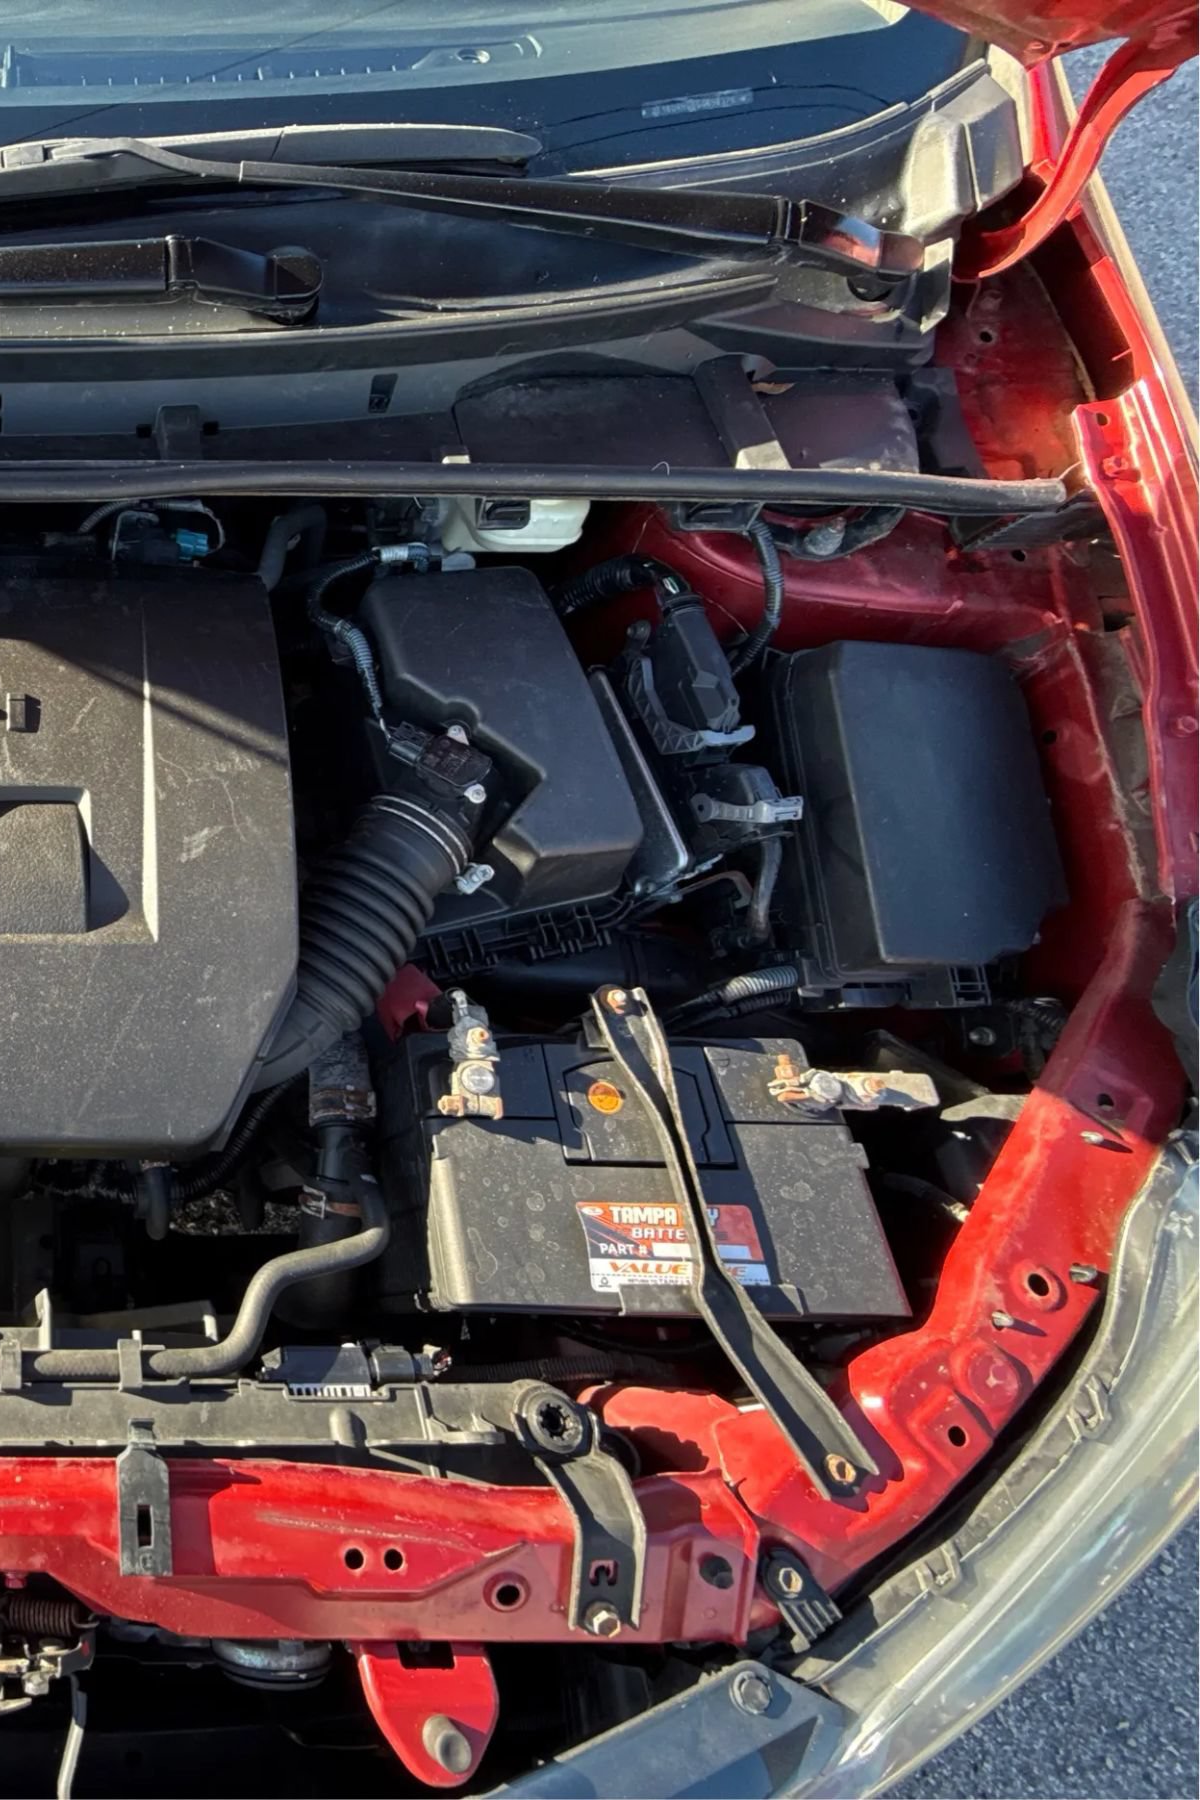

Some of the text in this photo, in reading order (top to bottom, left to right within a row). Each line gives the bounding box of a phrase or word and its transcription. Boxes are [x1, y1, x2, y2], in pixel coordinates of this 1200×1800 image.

[610, 1205, 677, 1225] TAMPA
[632, 1228, 687, 1241] BATTE
[600, 1242, 634, 1255] PART
[609, 1260, 688, 1276] VALUE
